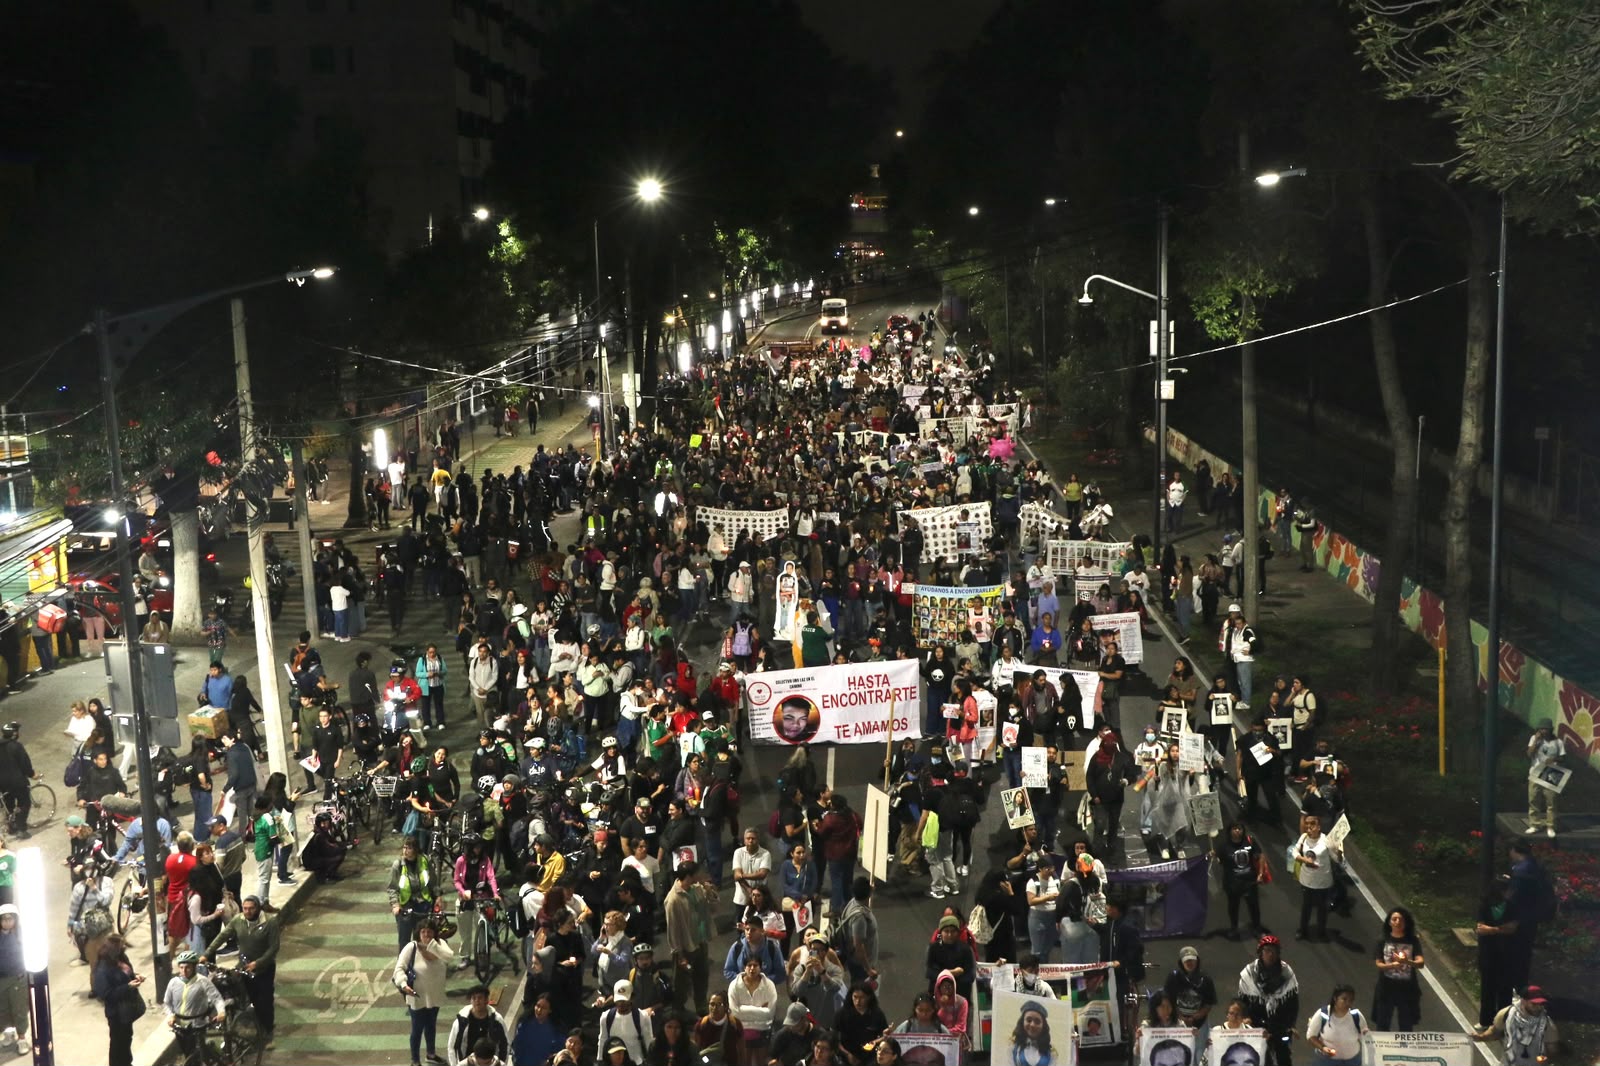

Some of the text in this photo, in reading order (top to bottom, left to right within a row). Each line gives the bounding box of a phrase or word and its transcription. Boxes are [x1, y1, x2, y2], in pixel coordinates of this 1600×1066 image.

[920, 586, 949, 594] AYUDANOS
[954, 587, 996, 595] ENCONTRARLES
[848, 673, 890, 689] HASTA
[822, 686, 917, 709] ENCONTRARTE
[834, 717, 908, 739] TE AMAMOS
[1039, 966, 1060, 974] RQUE
[1394, 1033, 1445, 1041] PRESENTES
